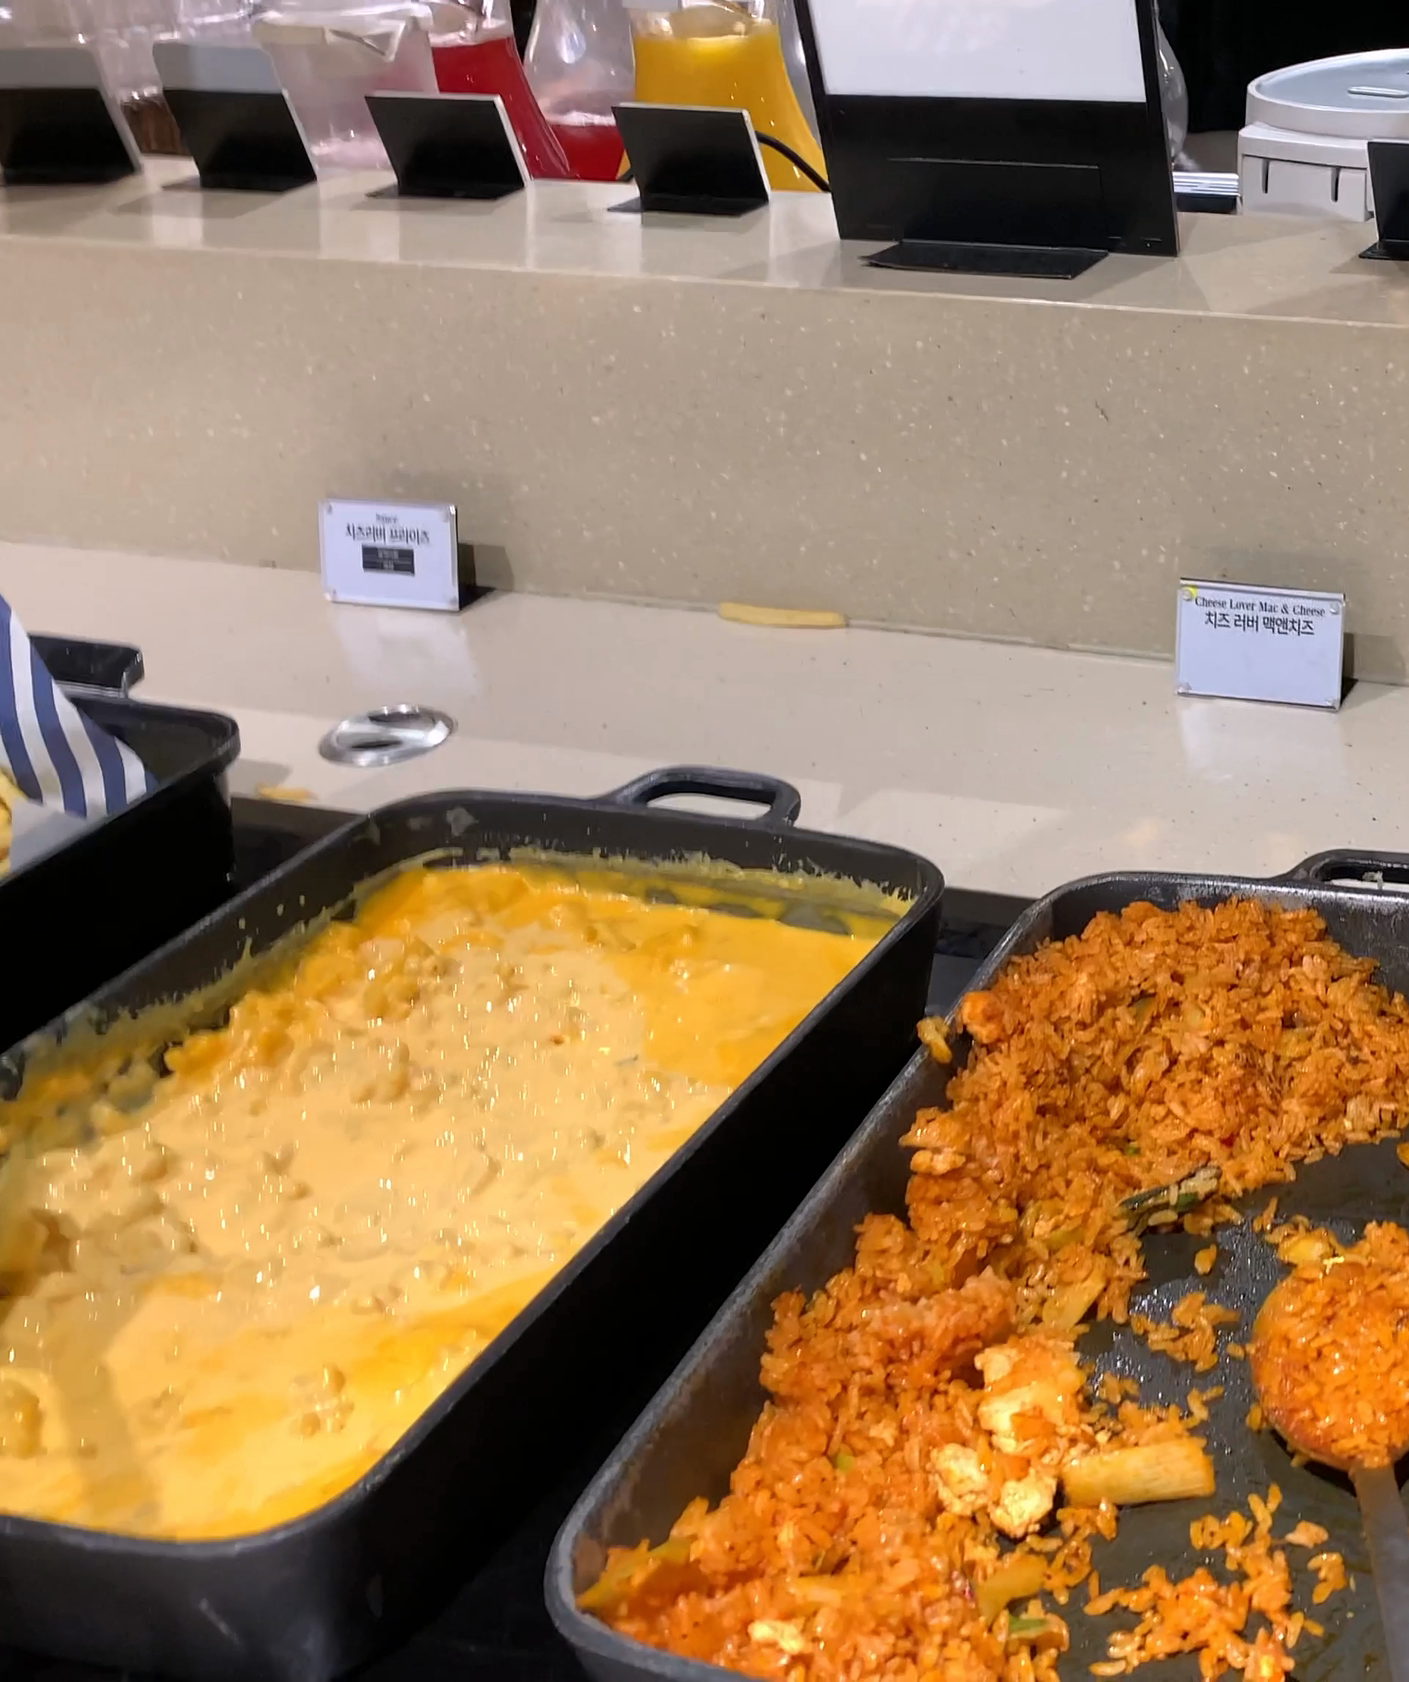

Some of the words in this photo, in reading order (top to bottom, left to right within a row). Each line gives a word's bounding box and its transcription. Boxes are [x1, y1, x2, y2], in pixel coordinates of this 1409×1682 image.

[1195, 596, 1226, 609] Cheese
[1230, 599, 1256, 611] Lover
[1259, 602, 1278, 614] Mac
[1281, 604, 1290, 615] &
[1293, 605, 1326, 617] Cheese
[1205, 611, 1230, 629] 치즈
[1234, 614, 1259, 632] 러버
[1263, 616, 1314, 636] 맥앤치즈
